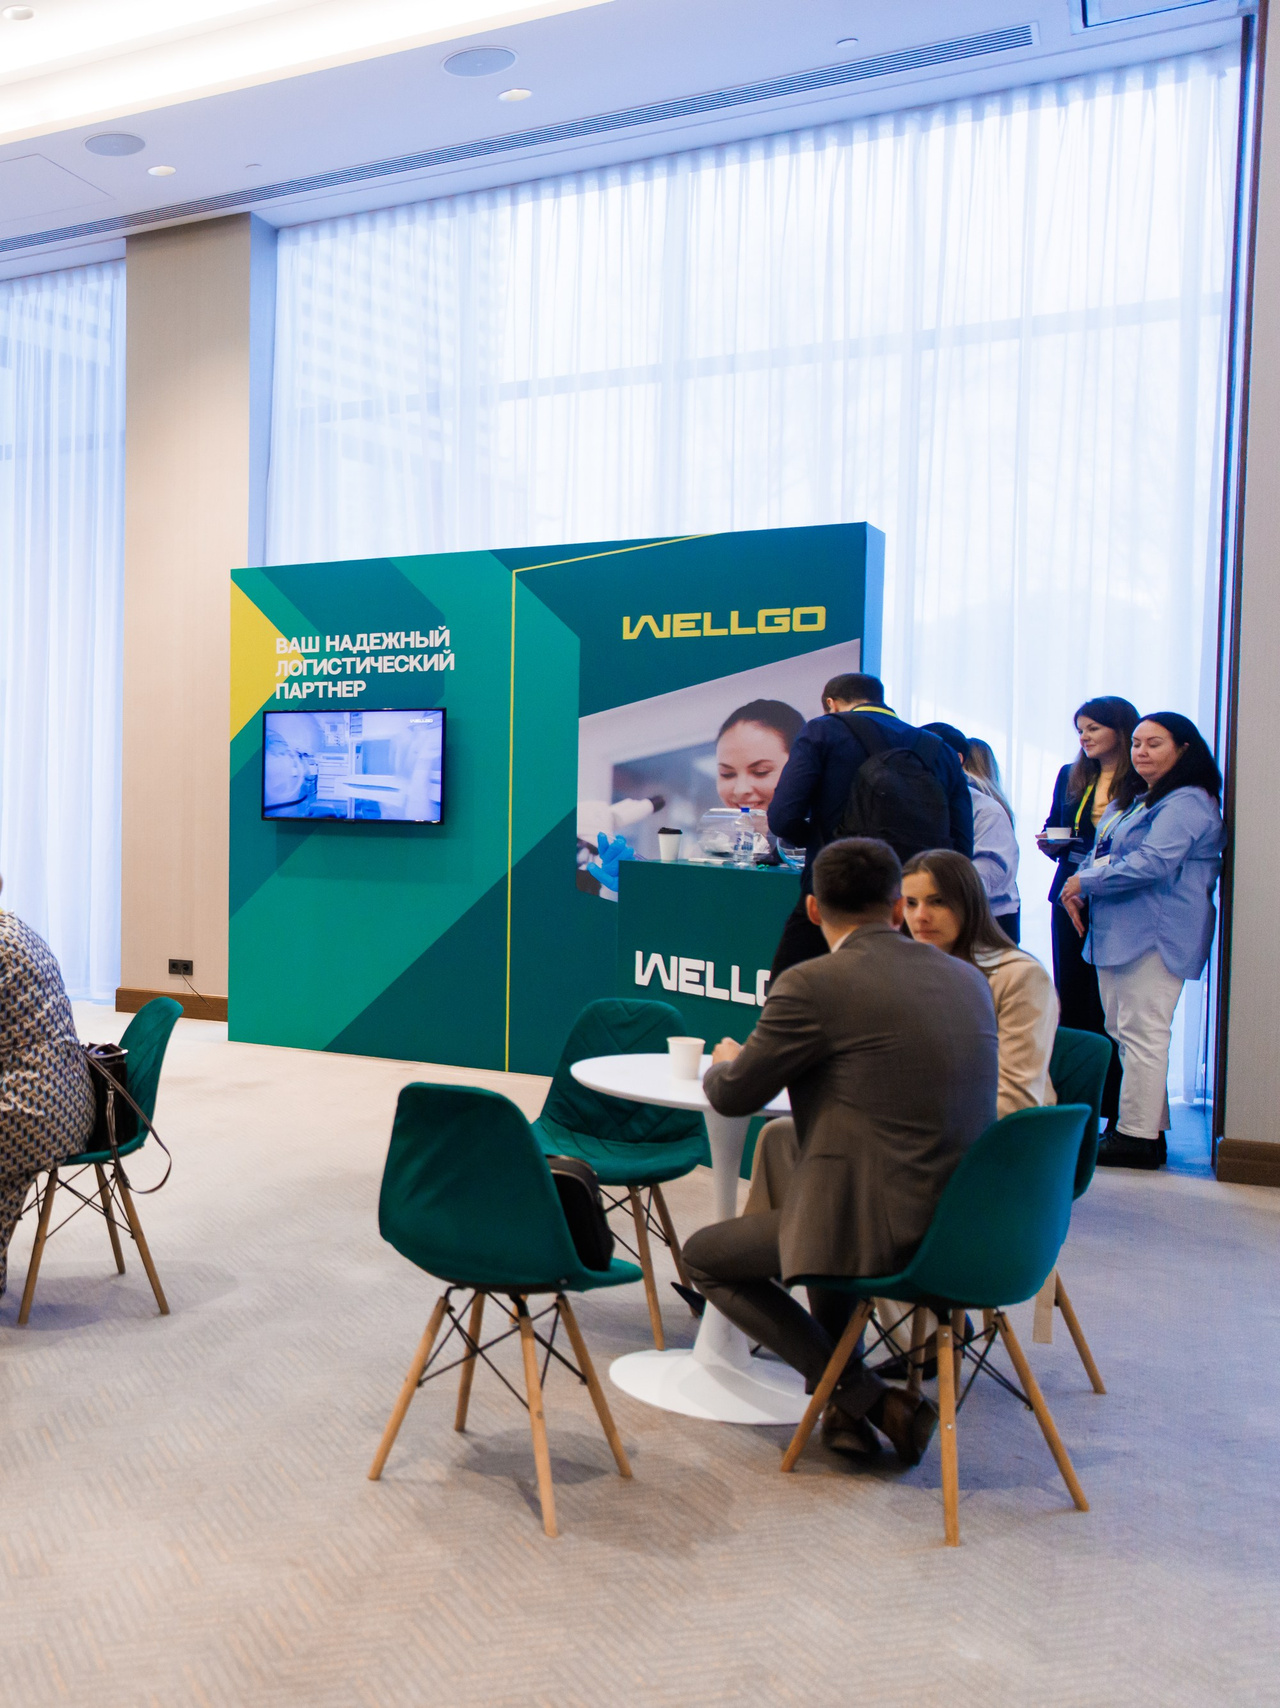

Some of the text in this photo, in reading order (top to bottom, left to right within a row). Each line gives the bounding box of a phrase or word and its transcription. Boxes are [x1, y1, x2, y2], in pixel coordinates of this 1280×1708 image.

[622, 605, 826, 640] WELLGO
[275, 625, 451, 655] ВАШ НАДЕЖНЫЙ
[275, 649, 455, 677] ЛОГИСТИЧЕСКИЙ
[275, 680, 367, 699] ПАРТНЕР
